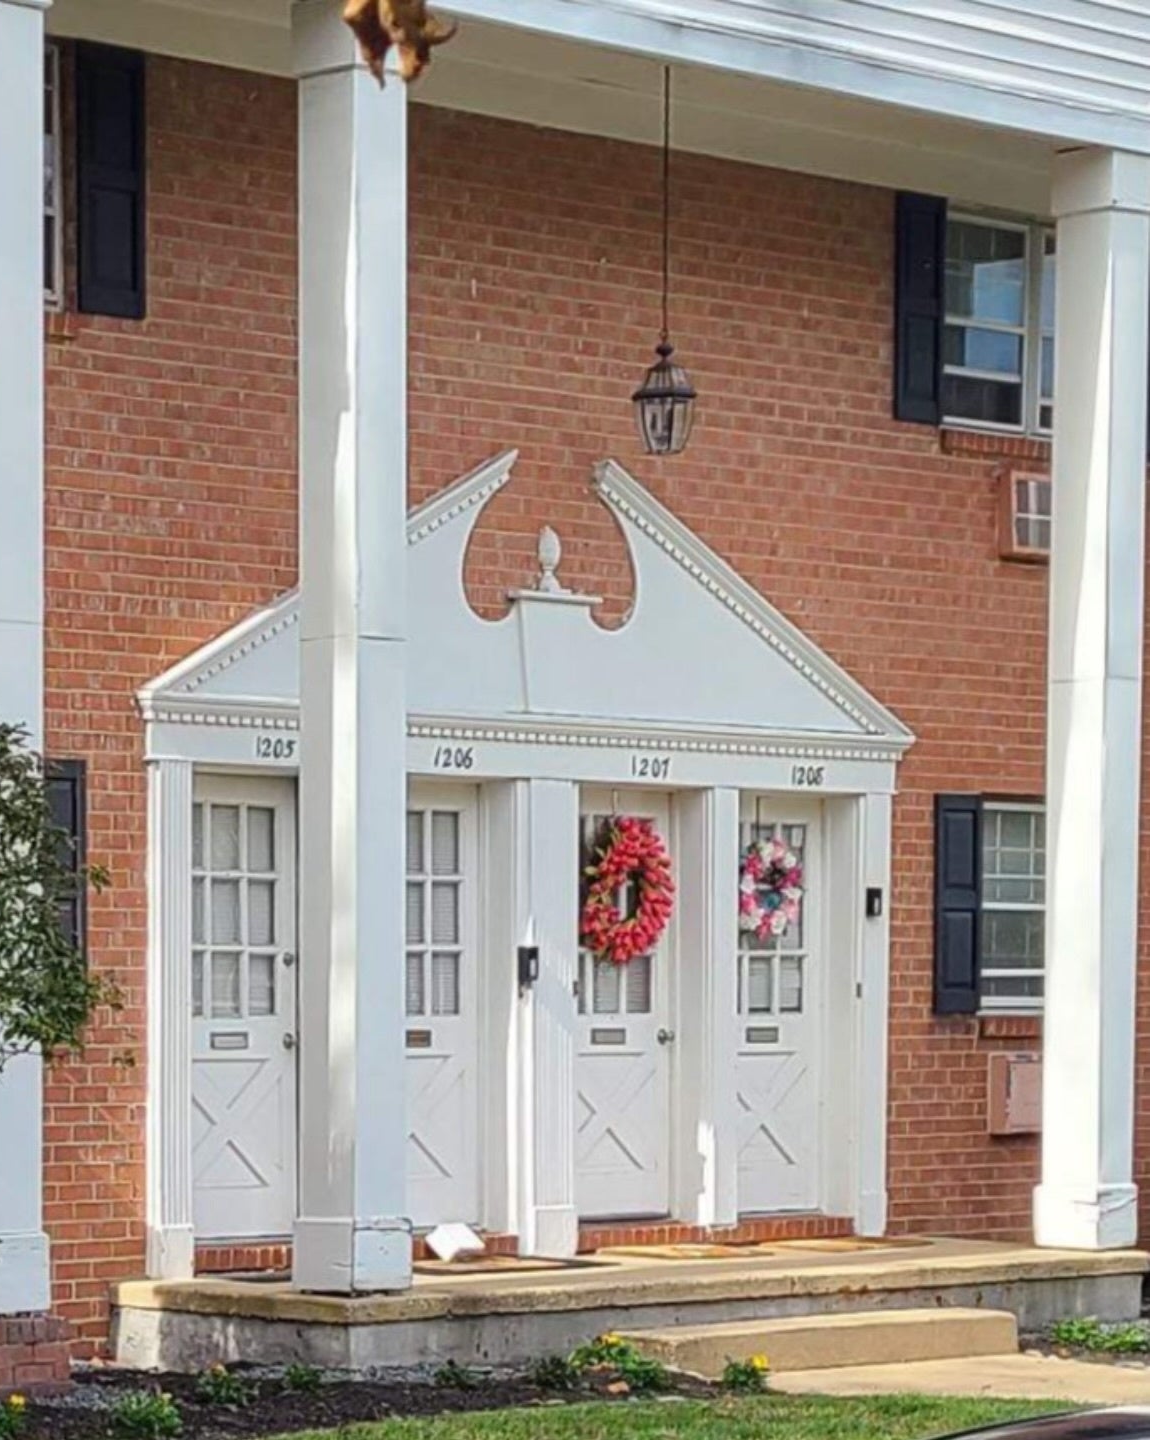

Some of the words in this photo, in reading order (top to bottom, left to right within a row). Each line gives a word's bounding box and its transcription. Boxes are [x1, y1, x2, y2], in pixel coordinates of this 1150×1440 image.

[256, 735, 297, 760] 1205
[433, 745, 474, 770] 1206
[631, 754, 671, 780] 1207
